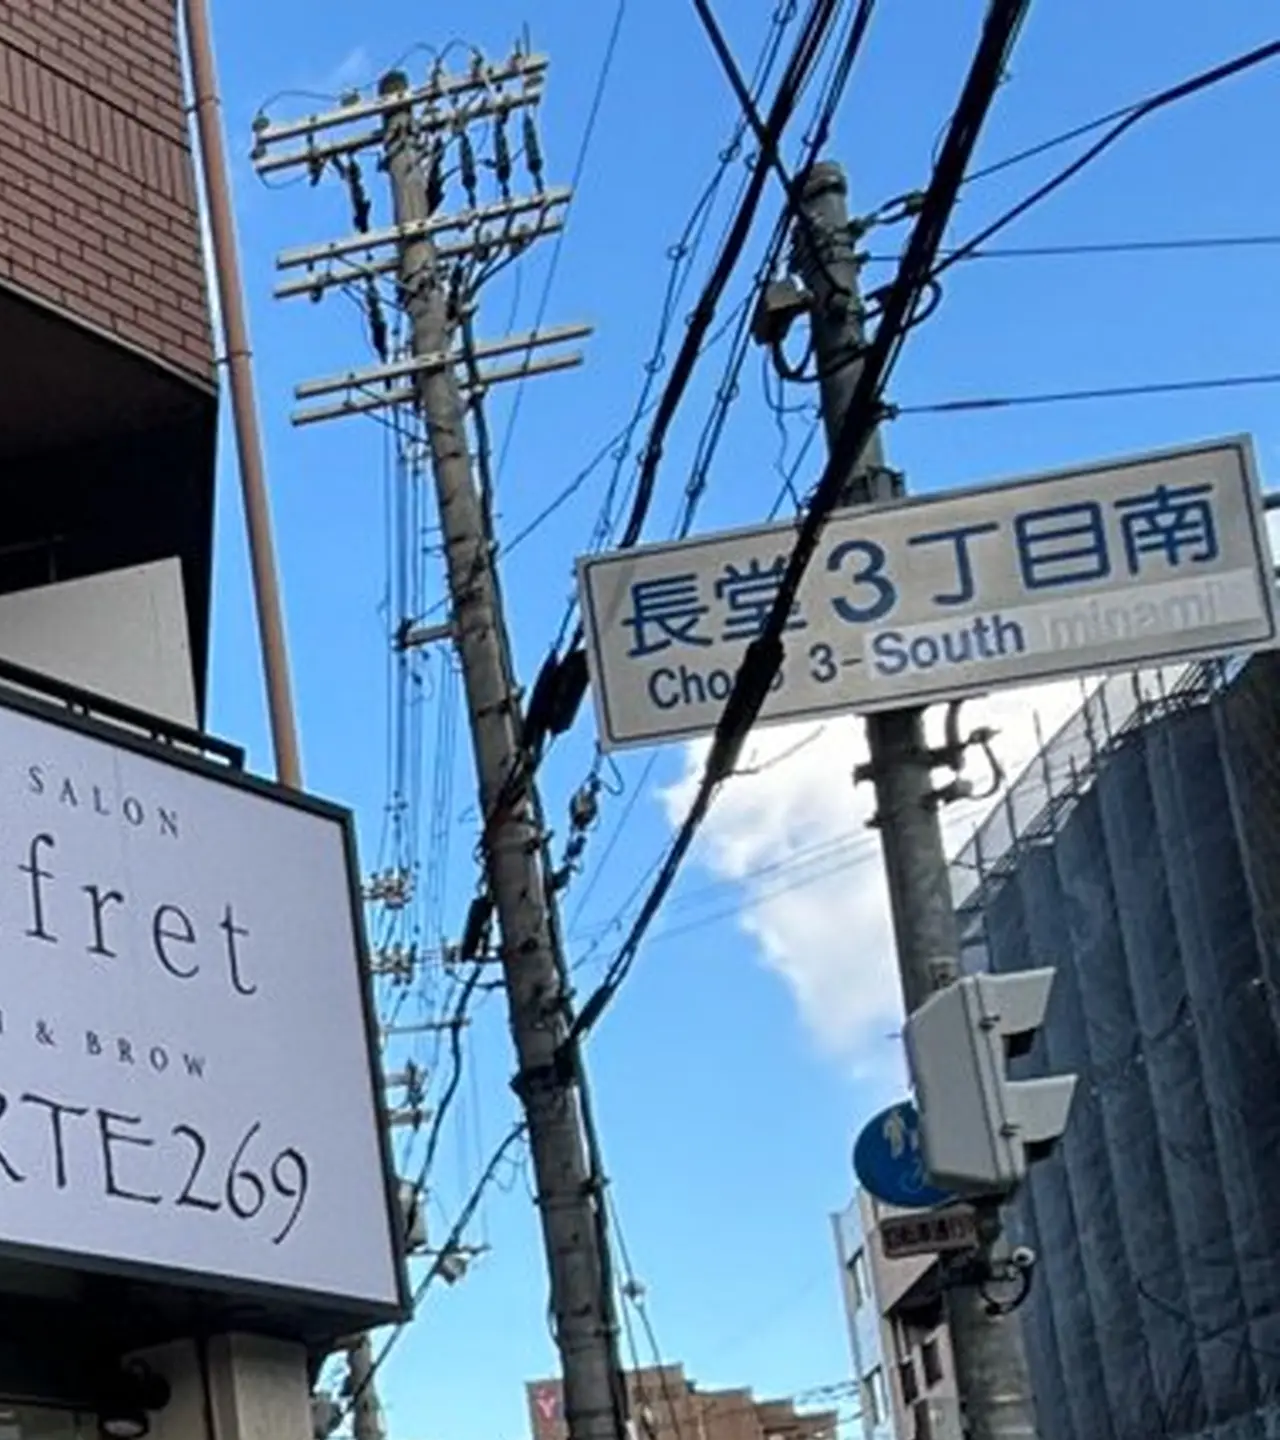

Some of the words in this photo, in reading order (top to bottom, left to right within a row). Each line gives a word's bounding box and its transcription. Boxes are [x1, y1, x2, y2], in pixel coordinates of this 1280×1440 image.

[28, 764, 182, 838] SALON
[35, 1020, 55, 1046] &
[86, 1029, 208, 1079] BROW
